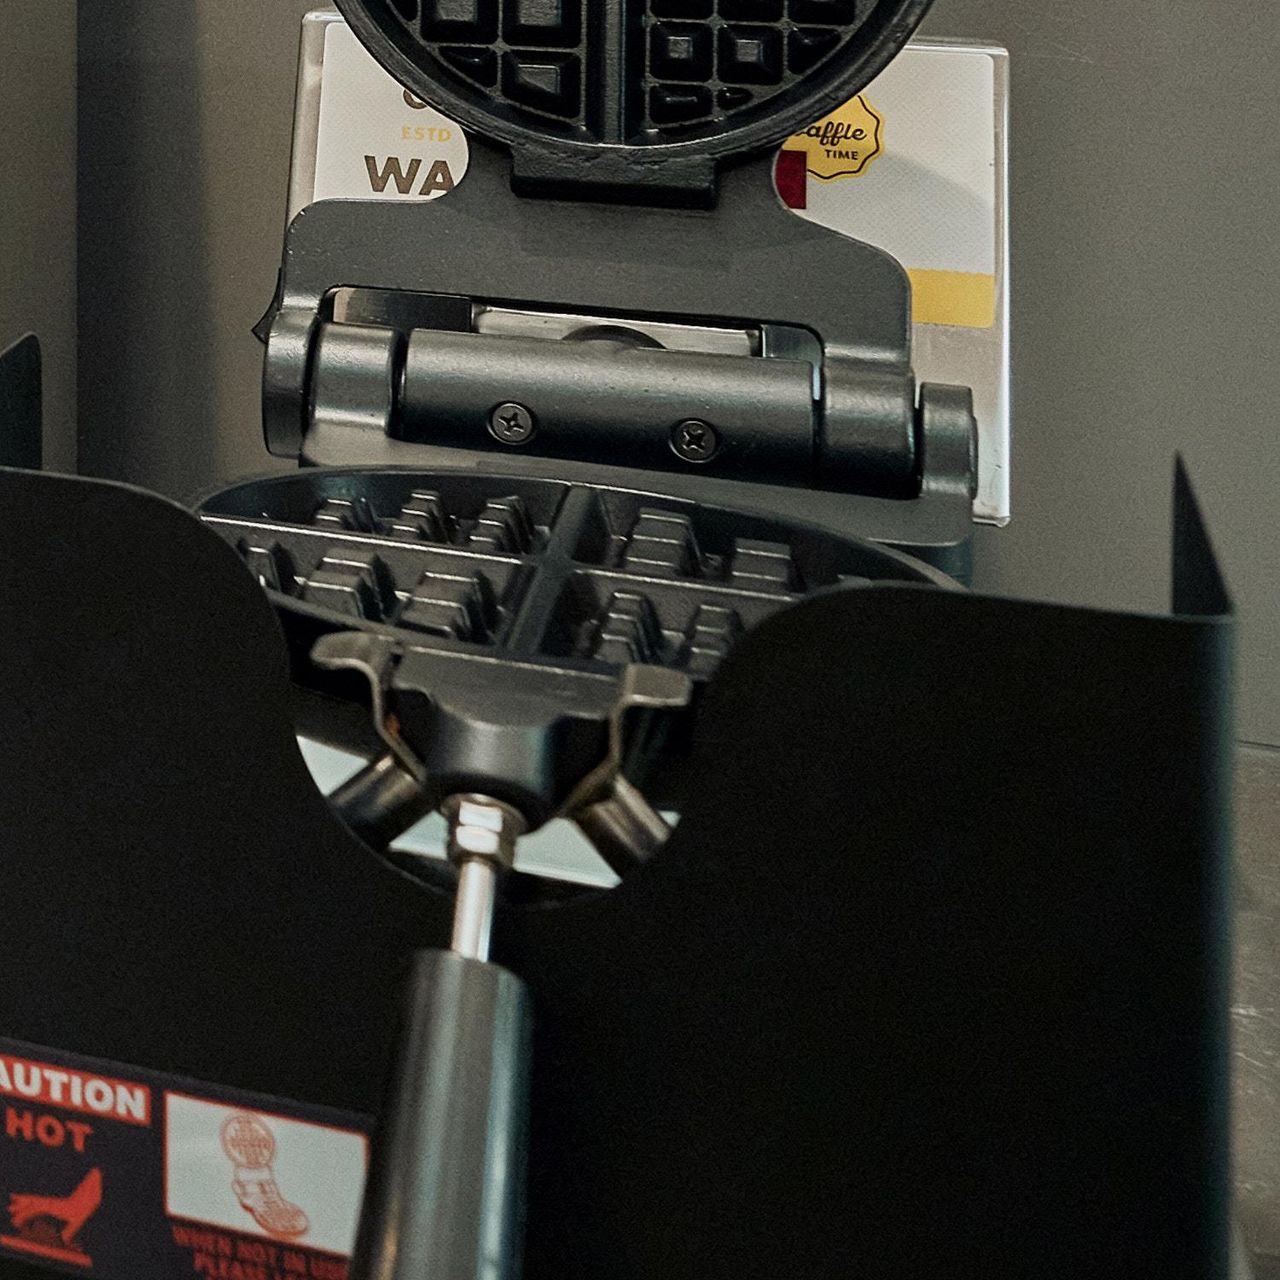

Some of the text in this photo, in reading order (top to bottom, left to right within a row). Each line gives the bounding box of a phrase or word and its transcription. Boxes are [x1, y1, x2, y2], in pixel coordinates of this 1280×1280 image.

[401, 126, 453, 142] ESTD
[825, 149, 859, 161] TIME
[364, 155, 457, 196] WA
[5, 1107, 93, 1153] HOT
